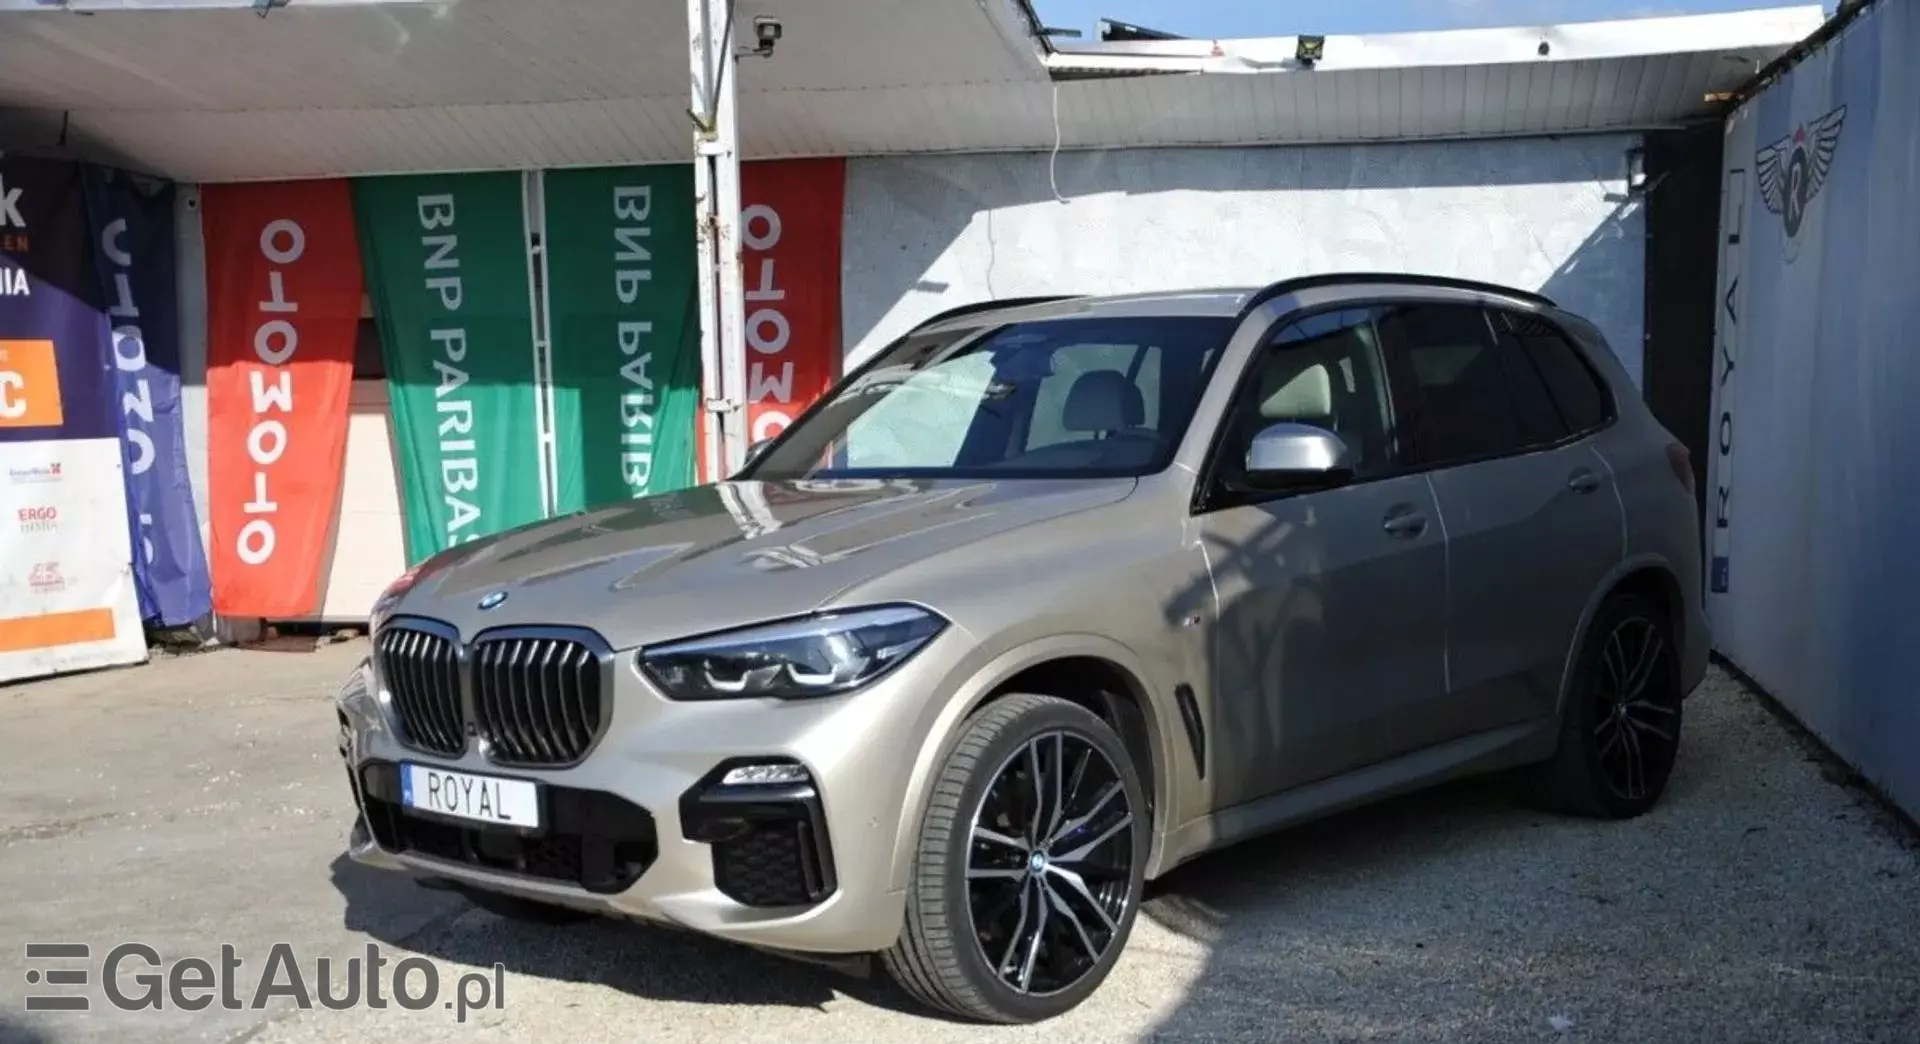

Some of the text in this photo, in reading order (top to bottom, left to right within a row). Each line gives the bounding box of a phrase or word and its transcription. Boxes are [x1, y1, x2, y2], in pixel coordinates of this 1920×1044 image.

[417, 194, 462, 311] BNP
[237, 219, 305, 565] OTOMOTO
[1717, 168, 1746, 529] ROYAL
[18, 506, 57, 523] ERGO
[428, 773, 512, 821] ROYAL
